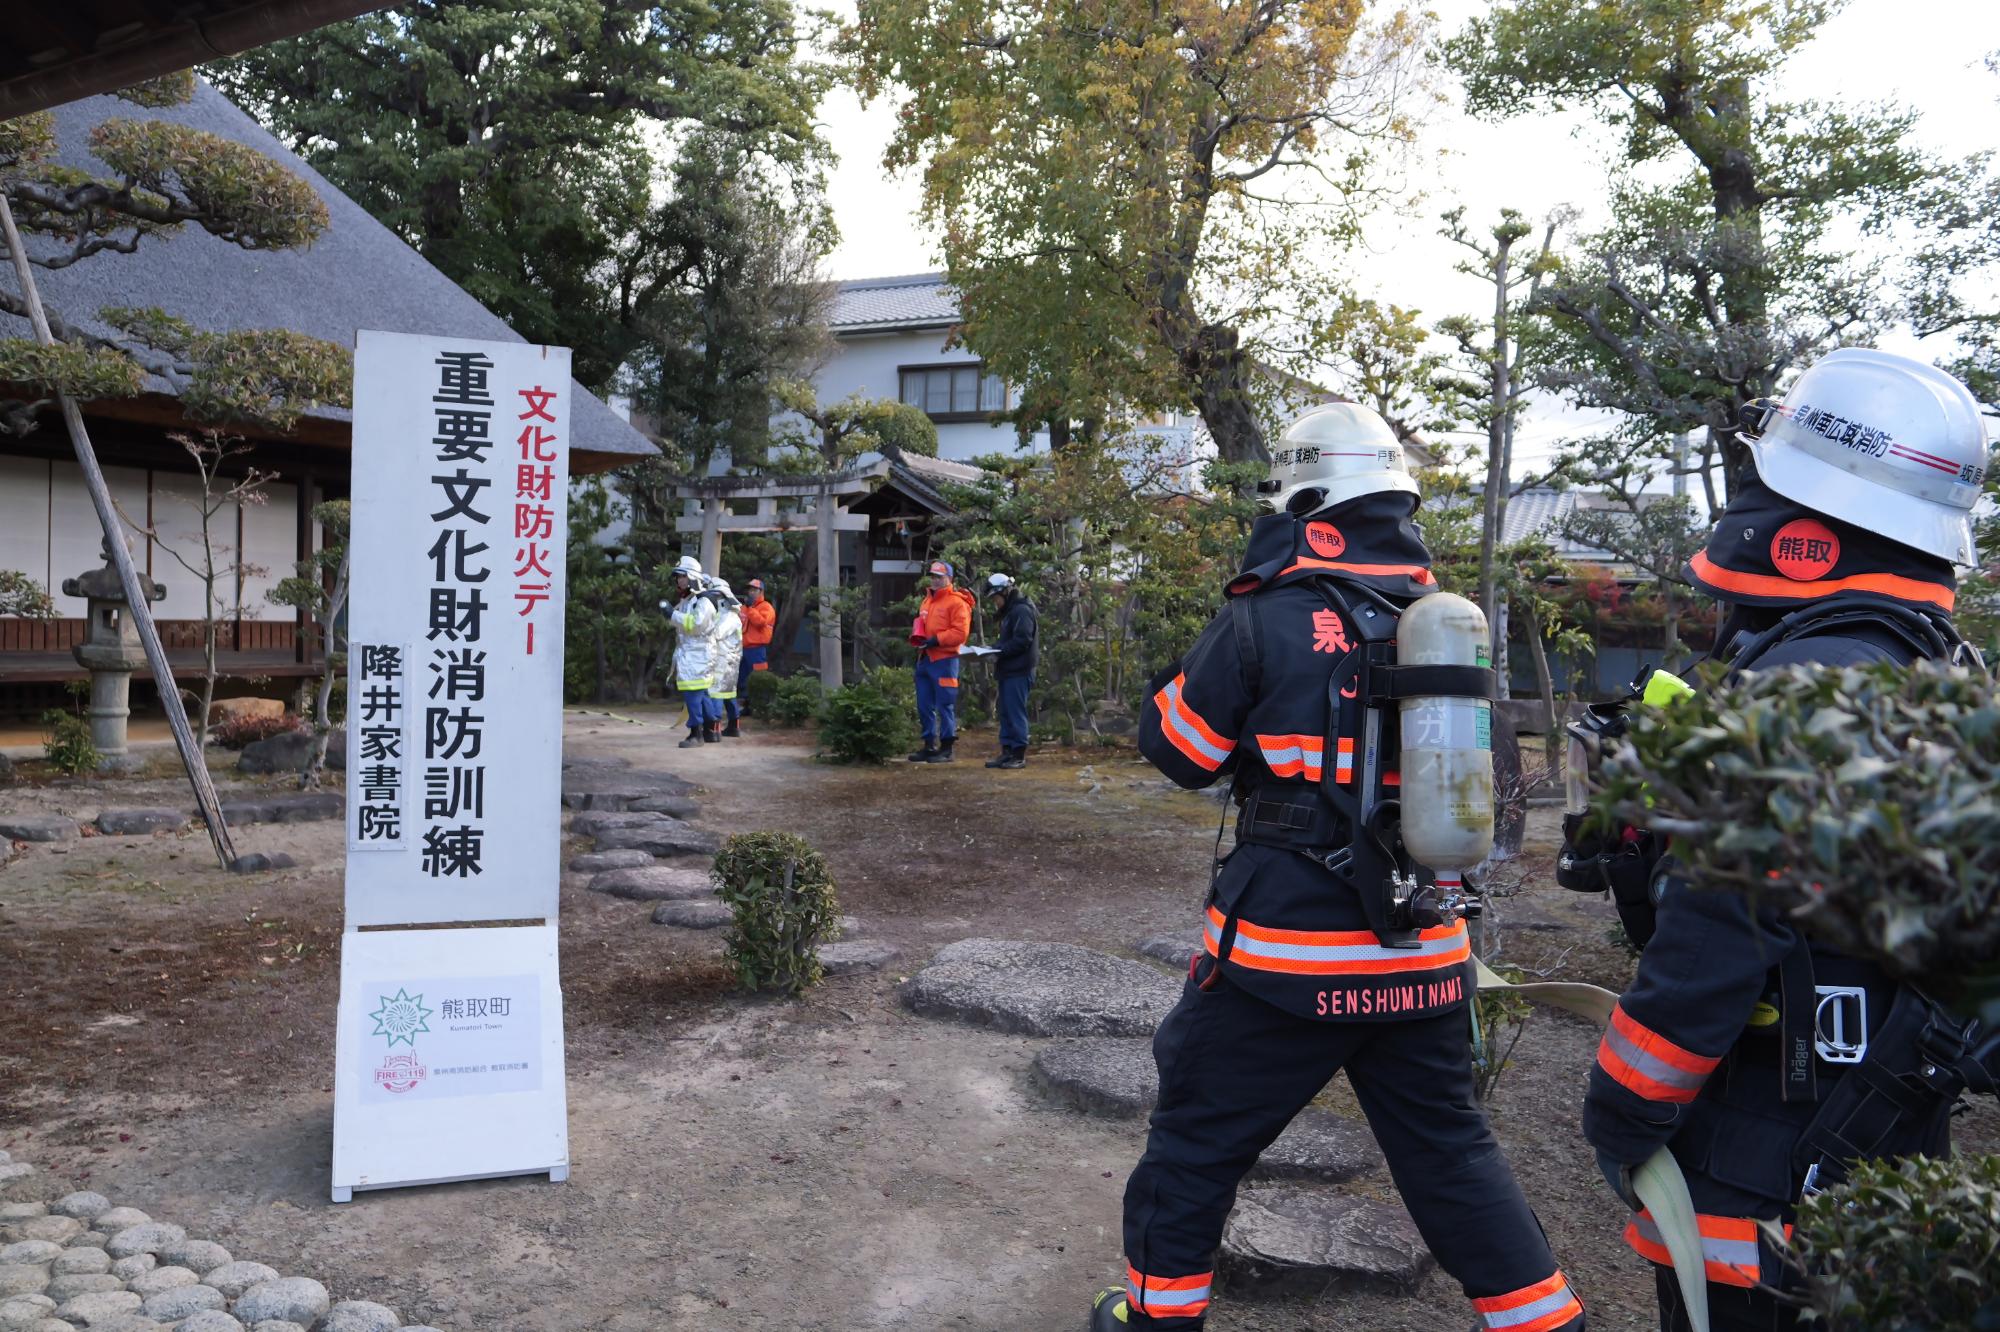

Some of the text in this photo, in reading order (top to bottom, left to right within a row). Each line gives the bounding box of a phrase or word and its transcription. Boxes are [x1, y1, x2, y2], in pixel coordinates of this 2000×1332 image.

[514, 385, 558, 655] 文化財防火デー
[1310, 528, 1341, 548] 熊取
[1777, 536, 1832, 563] 熊取
[422, 351, 494, 878] 重要文化財消防訓練
[358, 644, 402, 841] 降井家書院
[441, 997, 512, 1020] 熊取町
[1316, 976, 1463, 1016] SENSHUMINAMI
[450, 1024, 482, 1032] Kumatori
[376, 1068, 425, 1081] FIRE 119
[1791, 1036, 1808, 1081] Dräger
